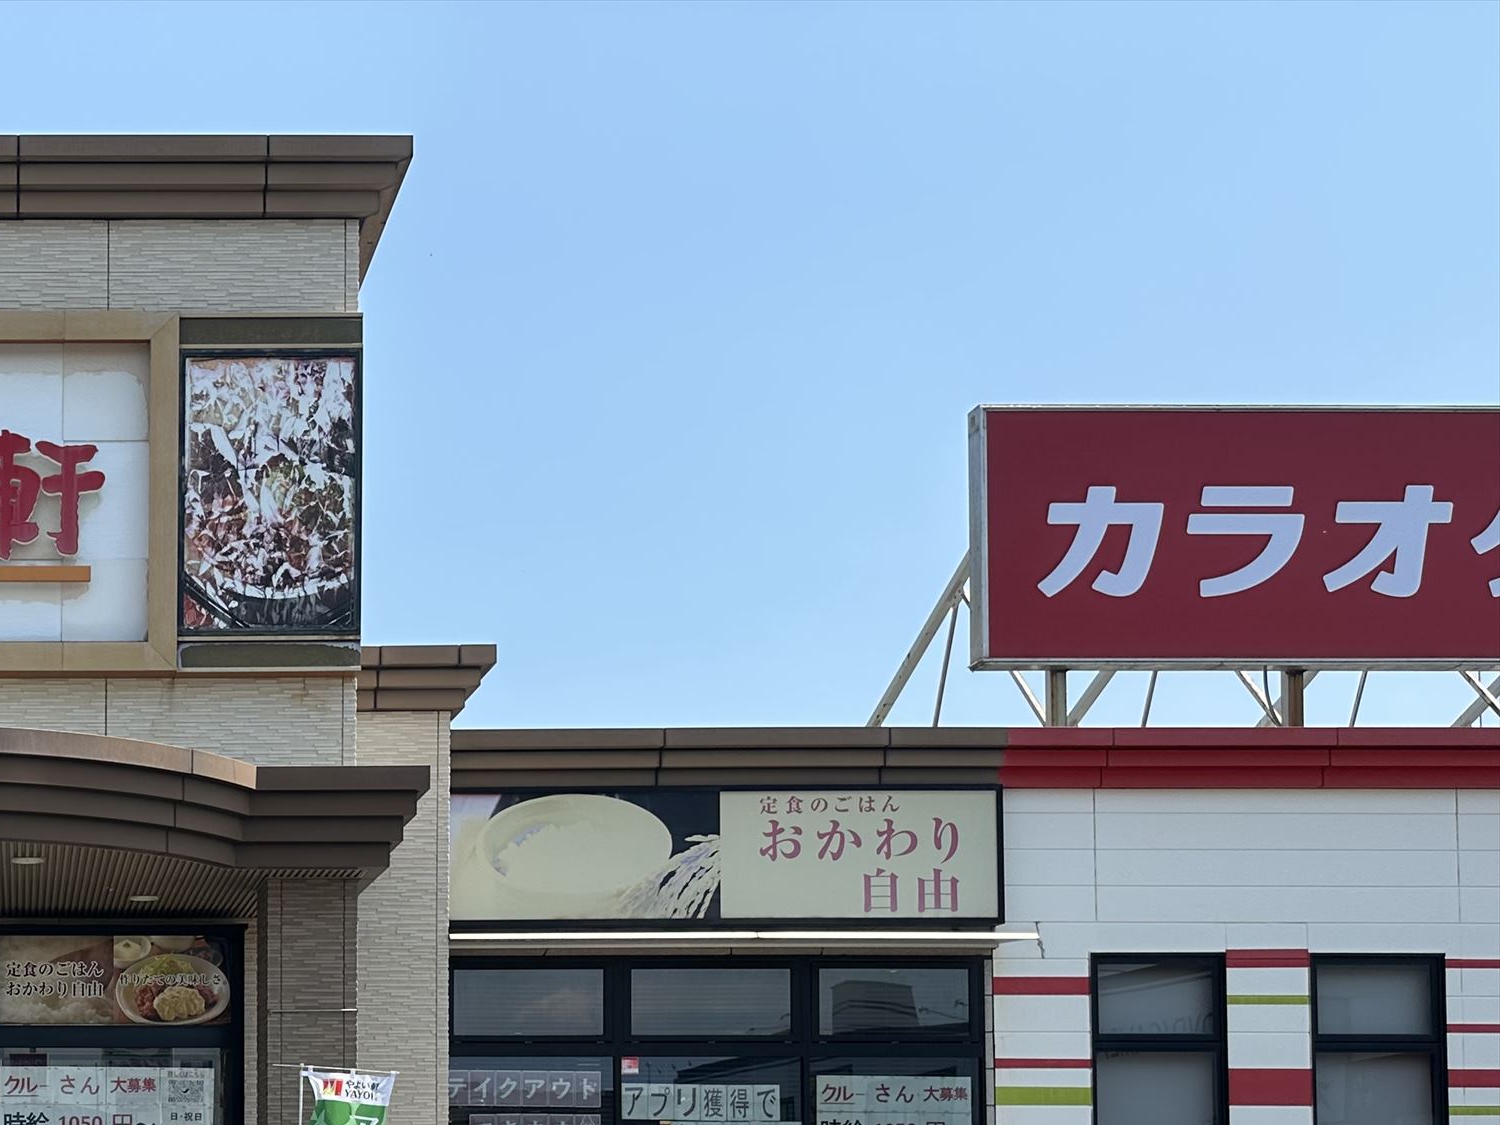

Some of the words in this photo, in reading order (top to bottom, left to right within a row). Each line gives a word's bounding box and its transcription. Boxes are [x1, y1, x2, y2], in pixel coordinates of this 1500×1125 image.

[1037, 484, 1500, 599] カラオ
[760, 796, 900, 814] 定食のごはん
[759, 817, 960, 864] おかわり
[863, 867, 960, 913] 自由
[5, 960, 104, 978] 定食のごはん
[5, 980, 104, 998] おかわり自由
[624, 1086, 776, 1118] アプリ獲得で
